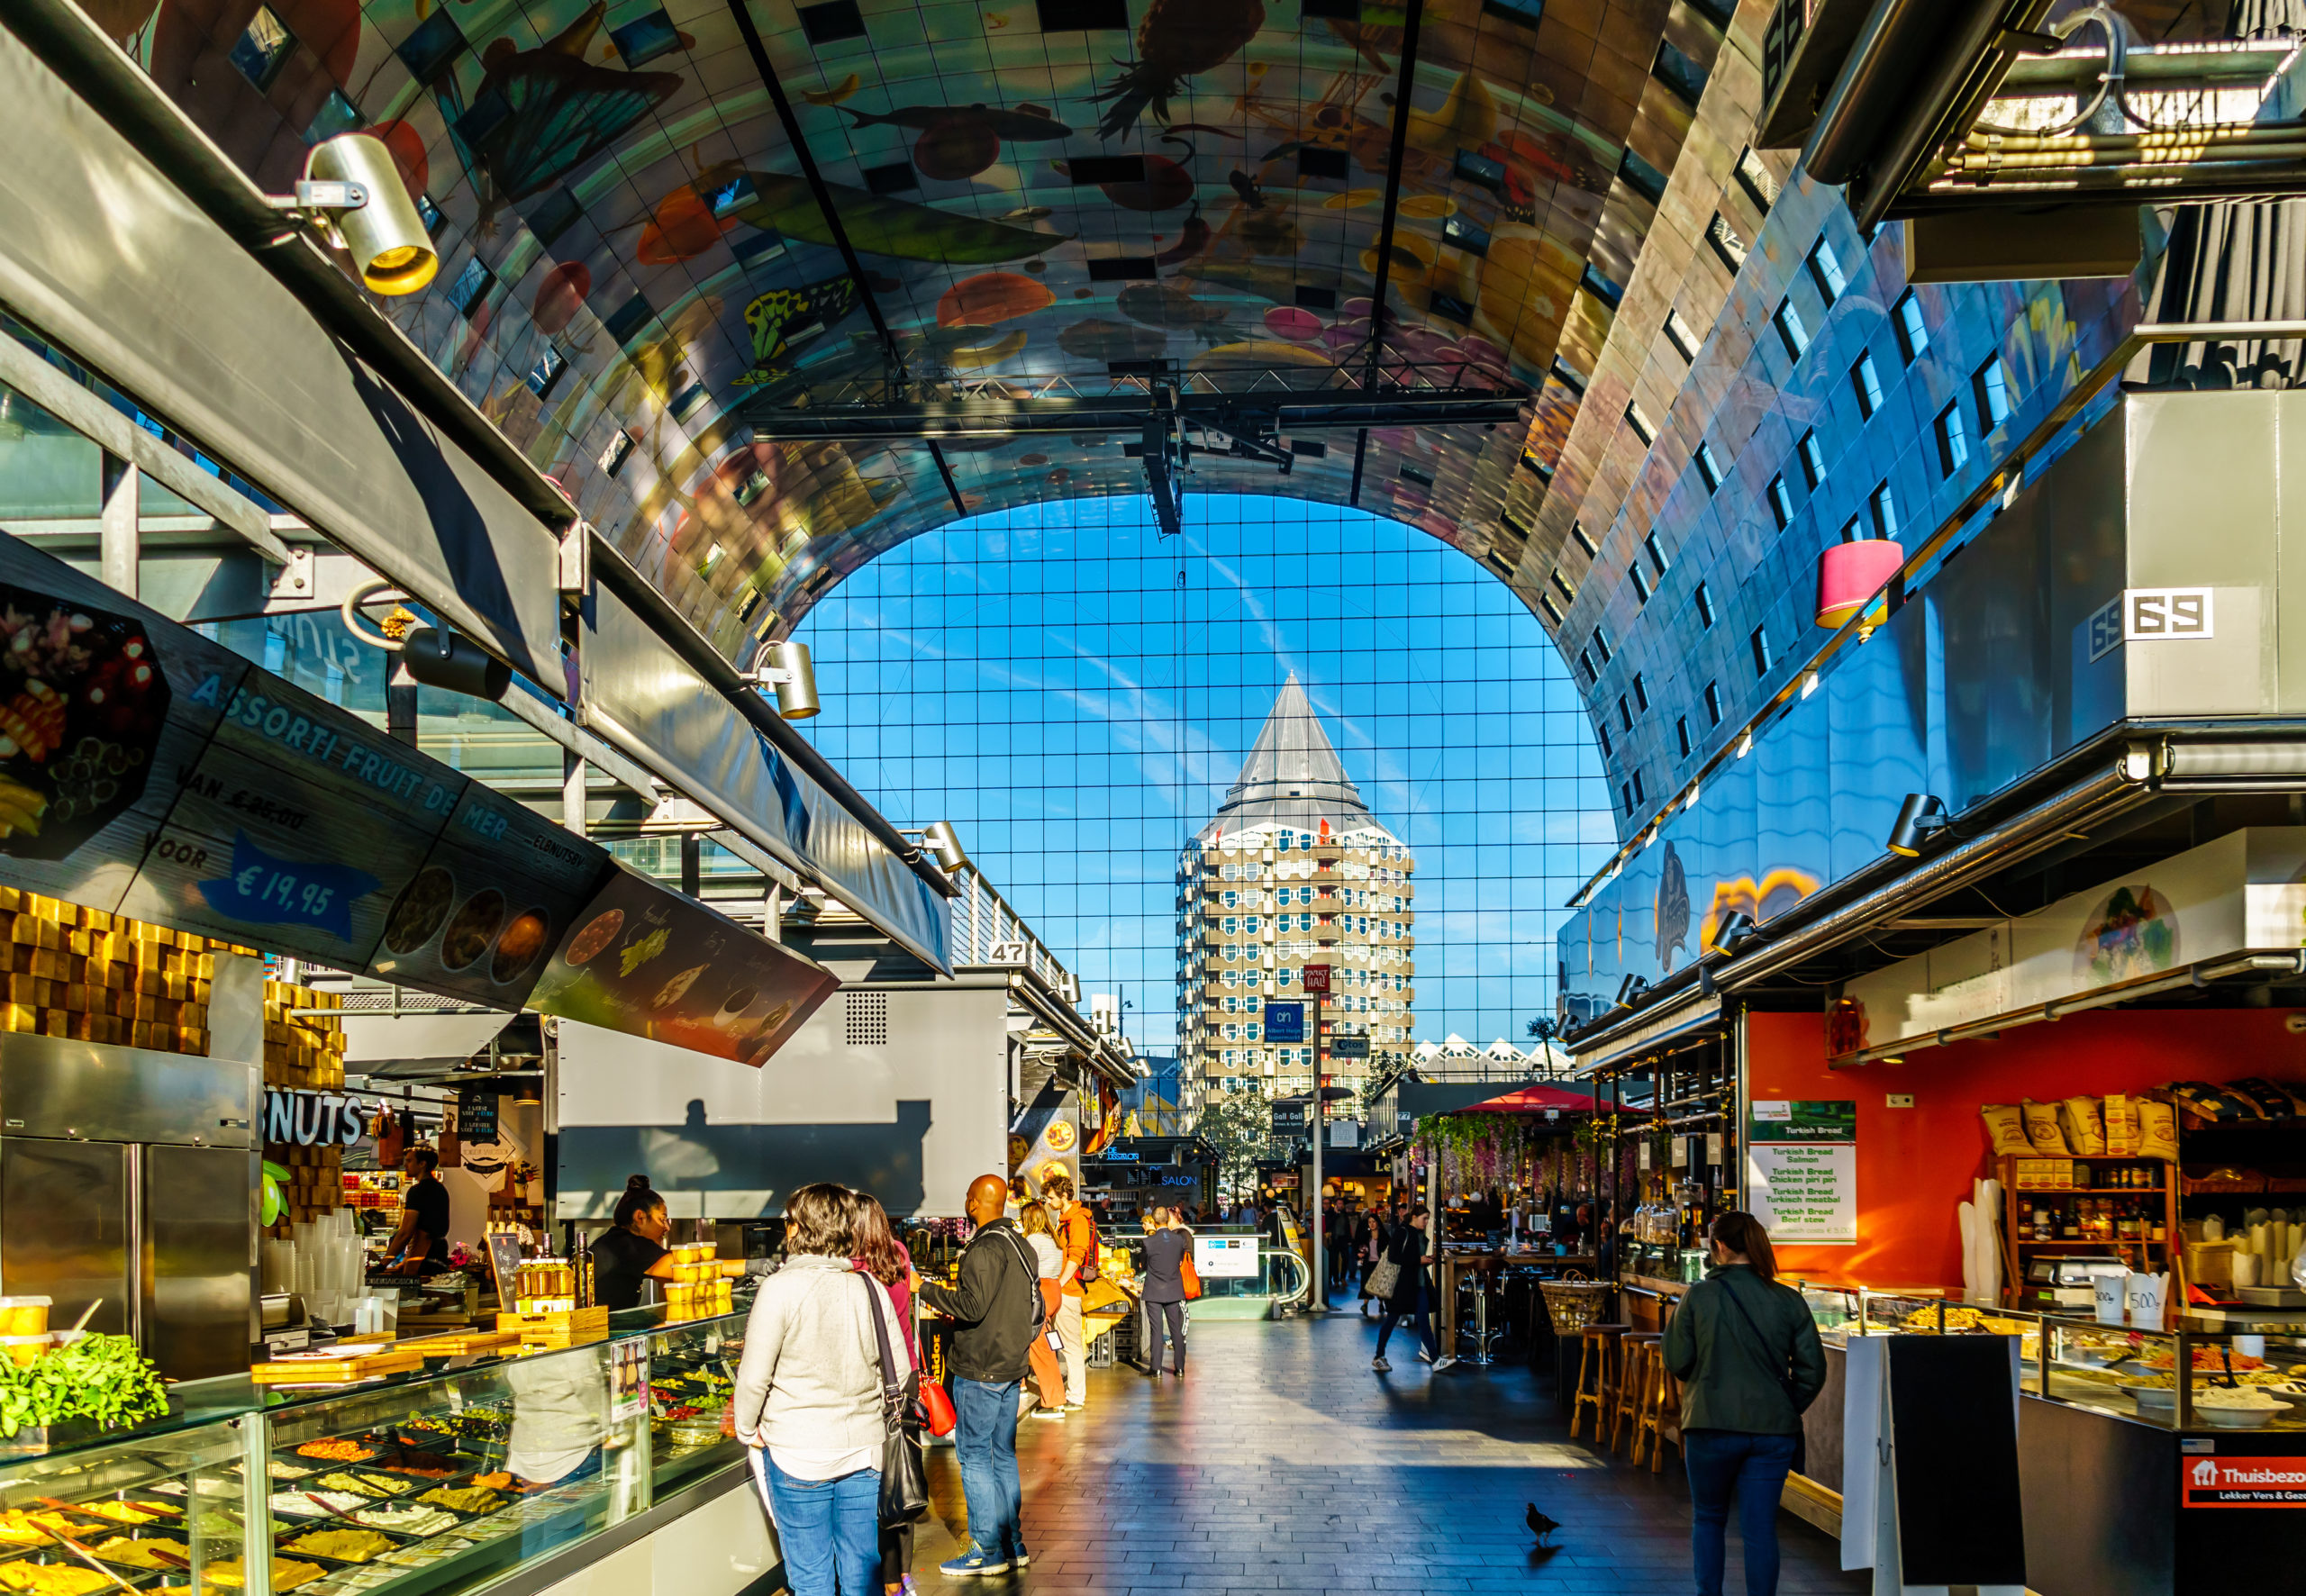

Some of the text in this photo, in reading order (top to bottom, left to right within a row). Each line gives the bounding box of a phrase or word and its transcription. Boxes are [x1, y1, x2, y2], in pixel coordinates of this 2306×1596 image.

[2134, 594, 2204, 634] 69
[2092, 600, 2121, 656] 69
[189, 675, 509, 841] ASSORTI FRUIT DE MER
[176, 768, 223, 800] VAN
[143, 830, 208, 870] VOOR
[235, 865, 335, 917] € 19,95
[992, 944, 1023, 961] 47
[263, 1091, 362, 1147] NUTS
[1274, 1112, 1303, 1120] Gall Gall
[1398, 1112, 1410, 1120] 77
[1772, 1147, 1834, 1156] Turkish Bread
[1786, 1156, 1820, 1164] Salmon
[1772, 1167, 1834, 1175] Turkish Bread
[1768, 1175, 1838, 1185] Chicken piri piri
[1772, 1187, 1834, 1196] Turkish Bread
[1766, 1195, 1841, 1203] Turkisch meatbal
[1772, 1207, 1834, 1216] Turkish Bread
[1781, 1216, 1826, 1224] Beef stew
[2219, 1491, 2252, 1500] Lekker
[2252, 1491, 2275, 1500] Vers
[2274, 1491, 2284, 1500] &
